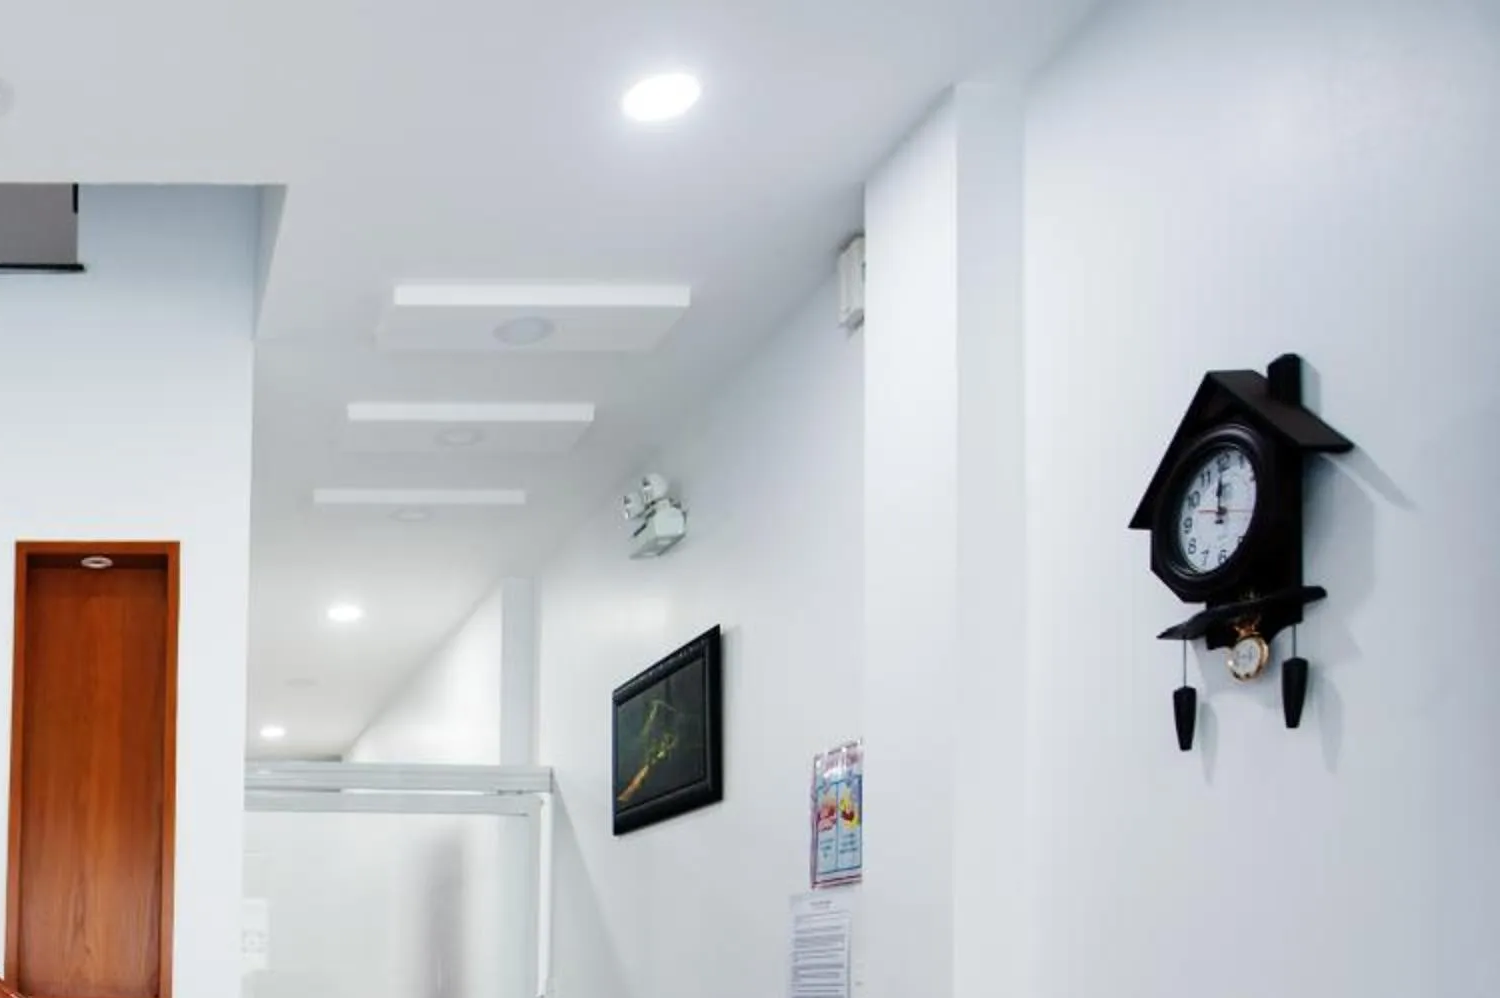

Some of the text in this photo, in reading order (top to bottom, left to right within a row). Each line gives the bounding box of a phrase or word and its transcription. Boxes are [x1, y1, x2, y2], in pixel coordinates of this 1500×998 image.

[1200, 470, 1211, 488] 11
[1187, 490, 1200, 509] 10
[1182, 517, 1192, 534] 9
[1200, 549, 1209, 566] 7
